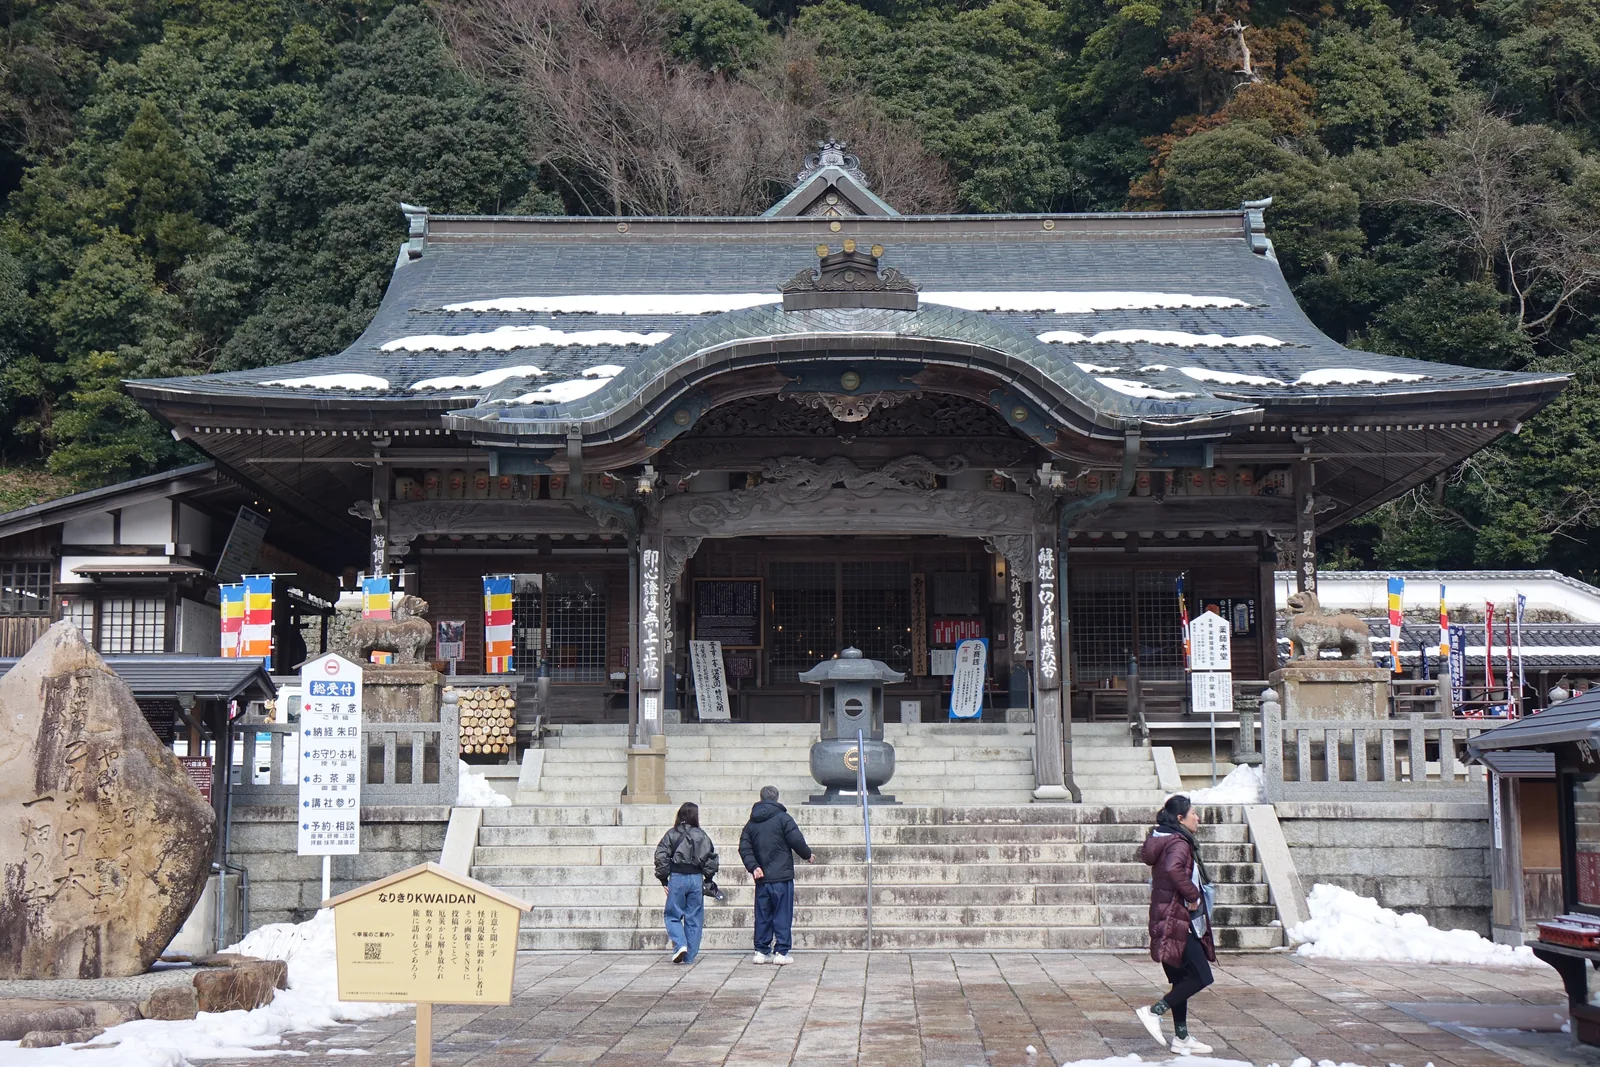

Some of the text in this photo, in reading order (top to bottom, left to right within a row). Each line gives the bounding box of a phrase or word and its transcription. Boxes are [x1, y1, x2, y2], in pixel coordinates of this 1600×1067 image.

[1219, 625, 1228, 661] 薬師本堂
[313, 681, 353, 696] 総受付
[314, 703, 357, 713] ご祈念
[312, 773, 356, 784] お茶湯
[311, 798, 356, 808] 講社参り
[377, 892, 477, 904] なりきりKWAIDAN
[411, 909, 421, 980] 旅に訪れるであろう
[423, 909, 434, 957] 数々の幸福が
[436, 909, 447, 980] 厄災から解き放たれ
[450, 909, 460, 965] 投稿することで
[463, 909, 473, 981] その画像をSNSに
[475, 909, 486, 997] 怪奇現象に襲われし者は
[489, 910, 499, 958] 注意を聞かず
